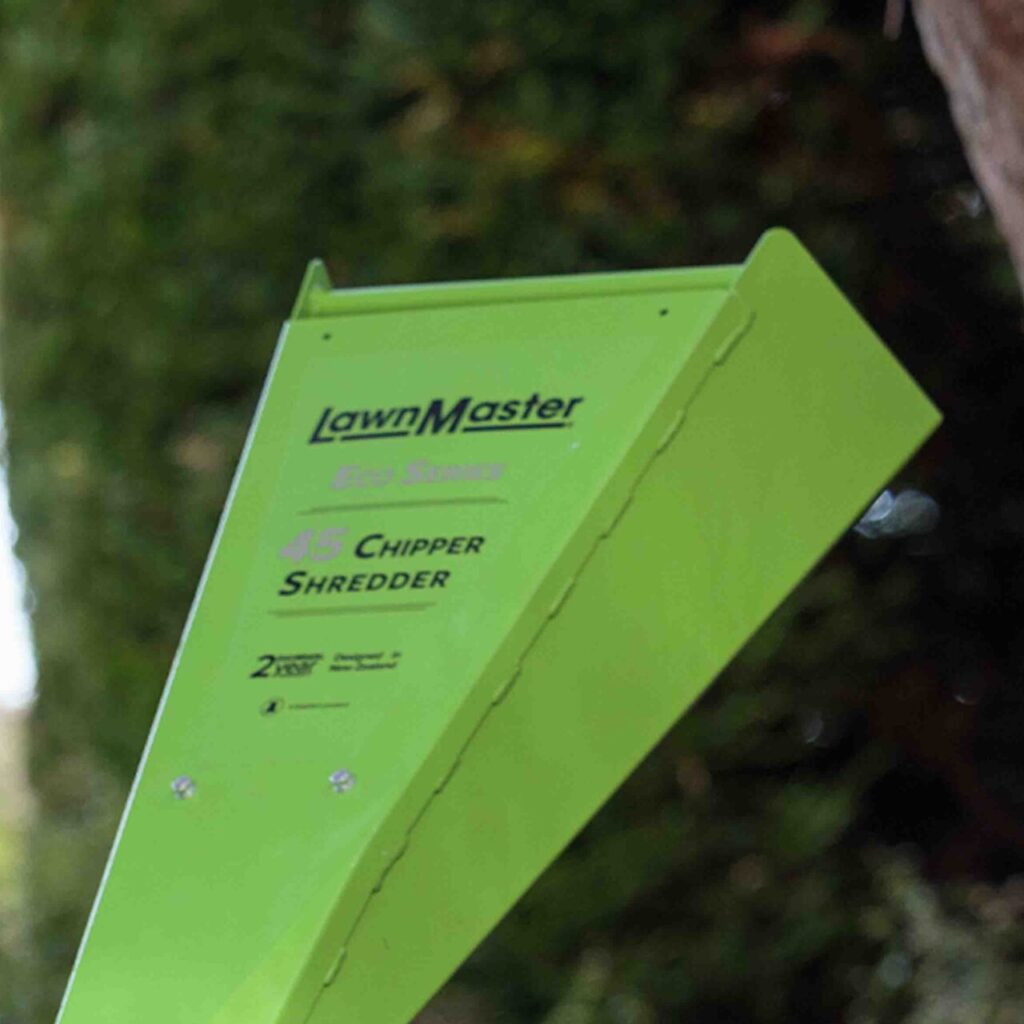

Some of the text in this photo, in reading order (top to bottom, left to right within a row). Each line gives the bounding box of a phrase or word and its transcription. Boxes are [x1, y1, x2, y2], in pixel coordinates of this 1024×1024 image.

[308, 394, 583, 444] LawnMaster
[279, 527, 347, 563] 45
[249, 654, 275, 678] 2
